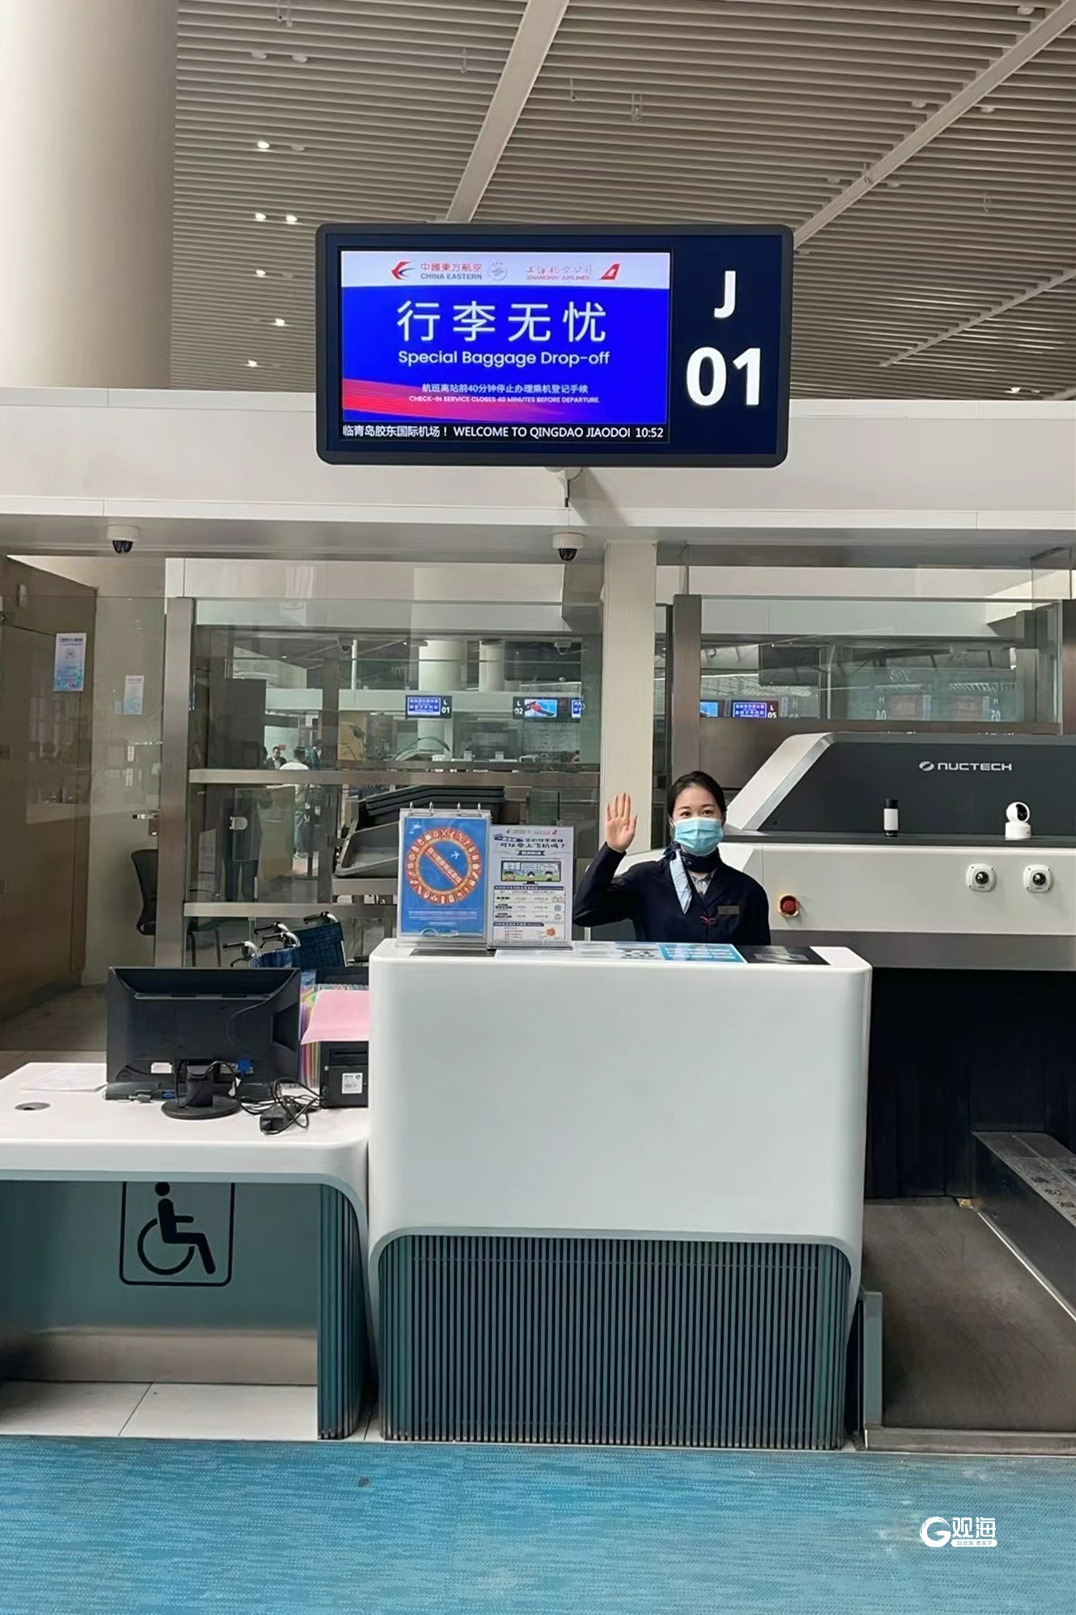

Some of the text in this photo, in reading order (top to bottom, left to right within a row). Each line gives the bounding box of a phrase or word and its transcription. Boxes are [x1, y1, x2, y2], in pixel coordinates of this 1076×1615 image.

[420, 263, 482, 272] 中國東方航空
[714, 270, 736, 318] J
[397, 300, 606, 342] 行李无忧
[398, 350, 610, 368] Special Baggage Drop-off
[686, 346, 760, 406] 01
[422, 383, 588, 394] 航班离站前40分钟停止办理乘机登记手续
[454, 427, 508, 438] WELCOME
[512, 427, 527, 438] TO
[530, 427, 584, 439] QINGDAO
[636, 427, 664, 438] 10:52
[938, 762, 1012, 771] NUCTECH
